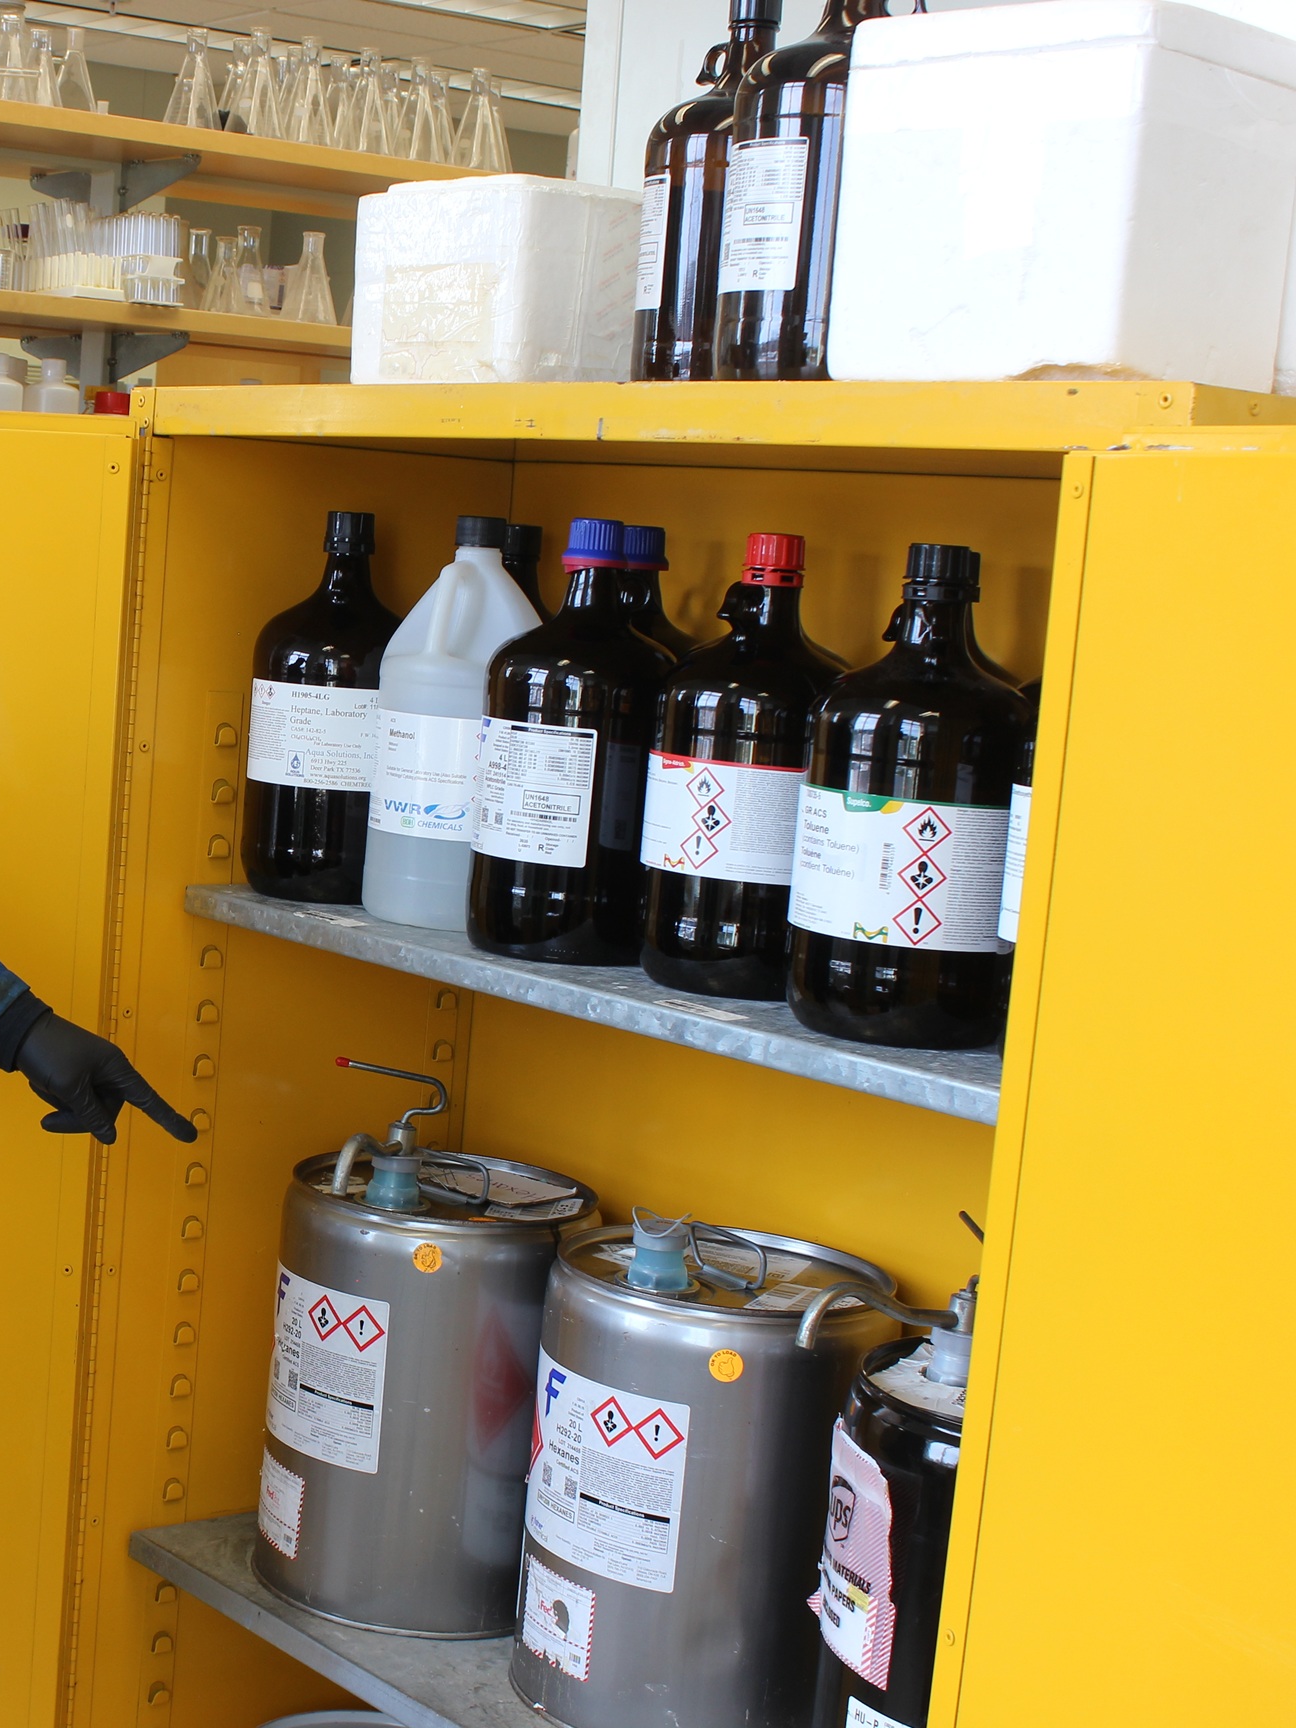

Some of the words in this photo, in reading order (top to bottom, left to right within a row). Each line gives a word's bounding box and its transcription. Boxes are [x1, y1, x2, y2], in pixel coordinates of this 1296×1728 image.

[291, 691, 330, 700] H1905-4LG
[290, 705, 323, 716] Heptane,
[325, 708, 367, 720] Laboratory
[289, 716, 312, 725] Grade
[389, 728, 416, 740] Methanol
[305, 748, 324, 757] Aqua
[326, 750, 362, 760] Solutions,
[525, 794, 550, 802] UN1648
[384, 799, 421, 815] VWR
[524, 802, 572, 812] ACETONITRILE
[813, 807, 828, 818] ACS
[417, 820, 463, 831] CHEMICALS
[804, 818, 830, 834] Toluene
[826, 837, 860, 854] Toluene)
[822, 863, 855, 879] Toluène)
[292, 1316, 298, 1326] 20
[545, 1368, 567, 1418] F
[569, 1419, 576, 1429] 20
[578, 1423, 582, 1432] L
[556, 1423, 581, 1444] H292-20
[548, 1439, 579, 1465] Hexanes
[570, 1465, 578, 1475] ACS
[550, 1502, 572, 1519] HEXANES
[598, 1500, 614, 1509] Product
[615, 1505, 645, 1518] Specifications
[832, 1557, 871, 1595] MATERIALS
[830, 1584, 855, 1613] PAPERS
